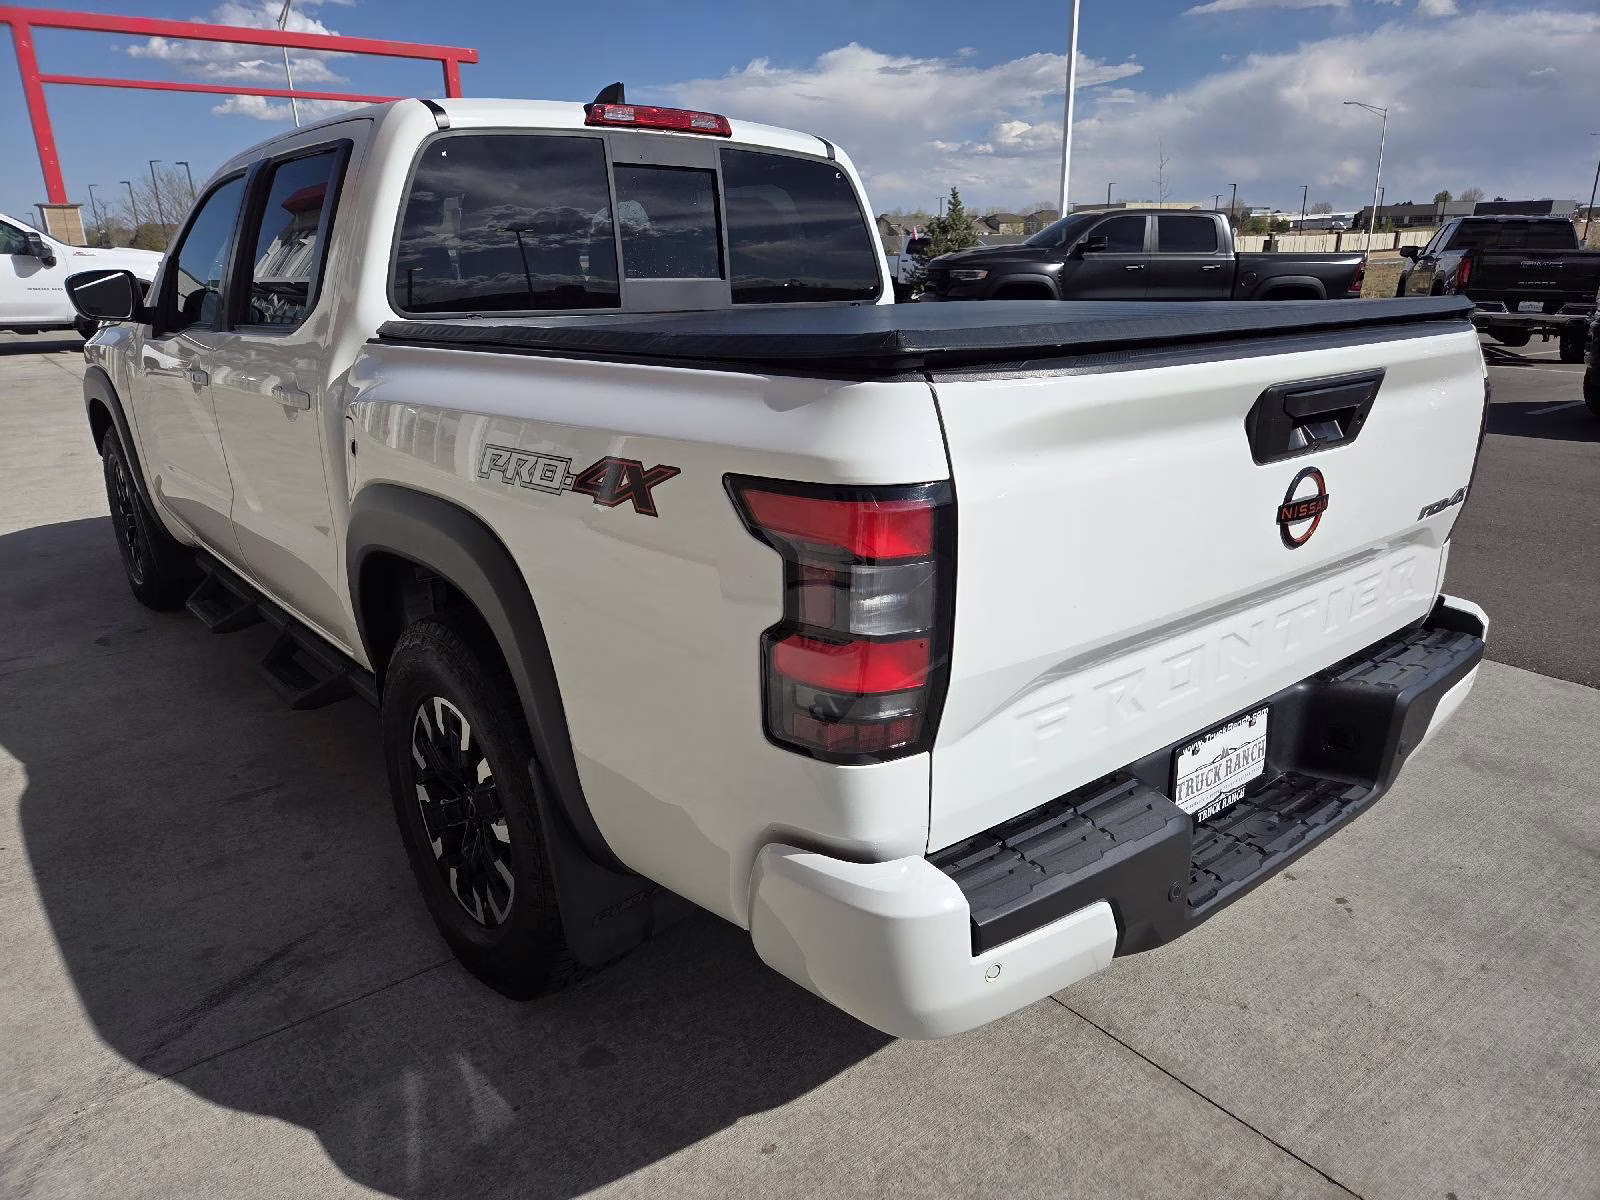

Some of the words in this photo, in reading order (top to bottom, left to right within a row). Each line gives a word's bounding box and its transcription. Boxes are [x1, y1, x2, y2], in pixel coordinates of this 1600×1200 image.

[477, 443, 682, 518] PRO-4X
[1281, 496, 1328, 520] NISSAN
[1009, 551, 1416, 768] FRONTIER
[1177, 763, 1222, 801] TRUCK
[1224, 738, 1265, 778] RANCH
[1197, 800, 1222, 823] TRUCK
[1221, 787, 1246, 809] RANCH
